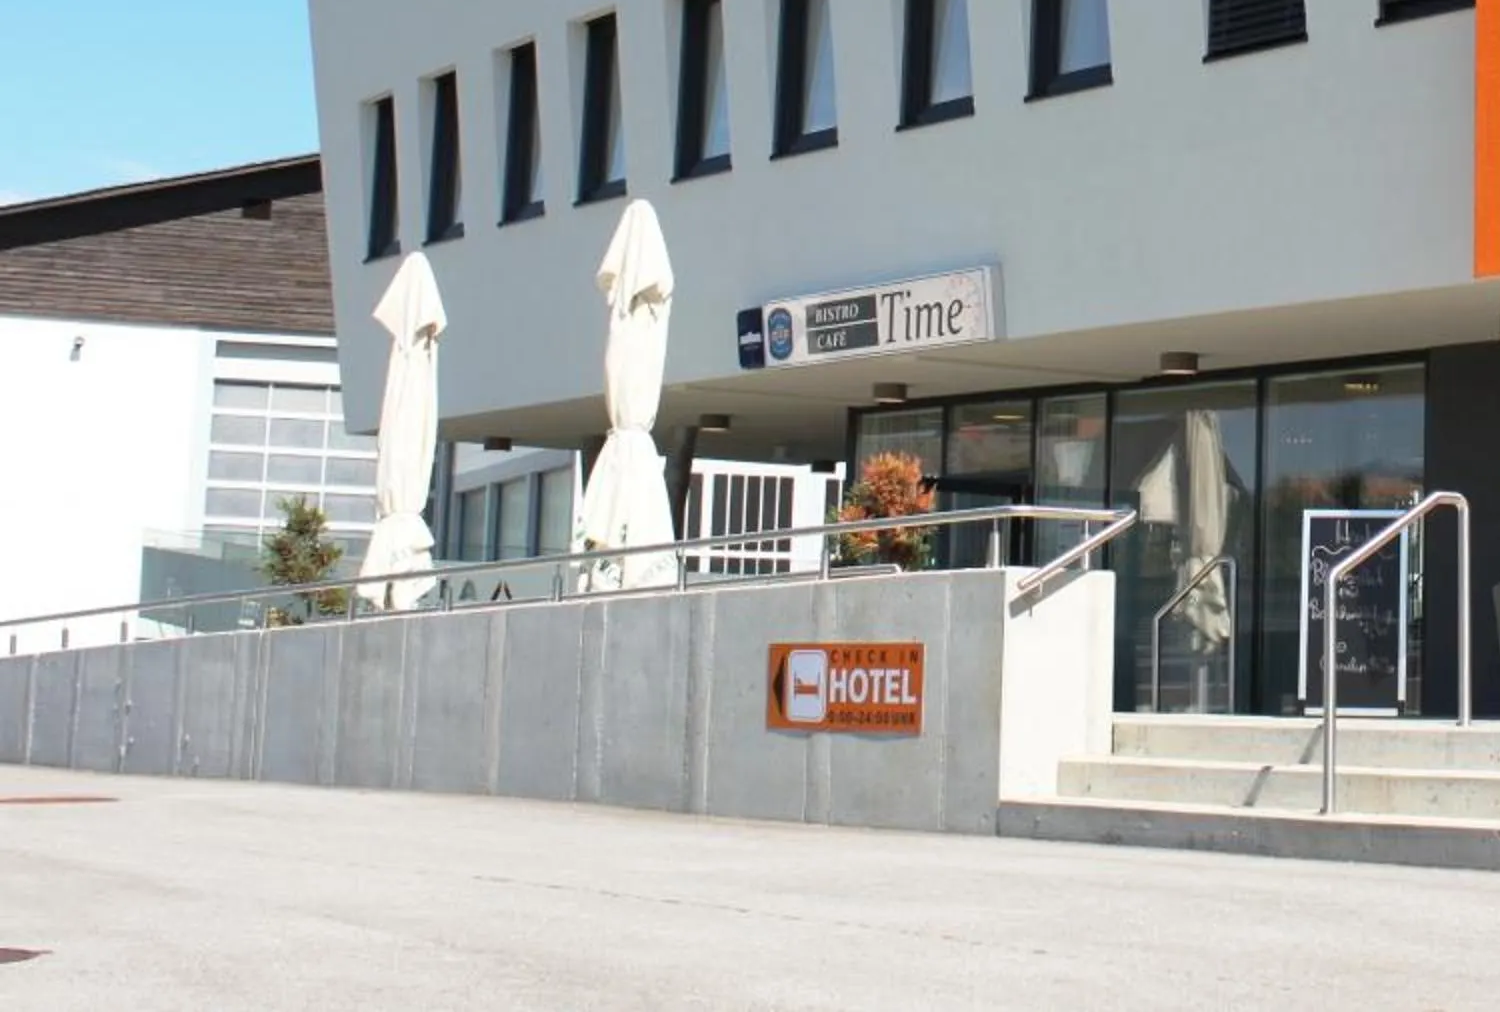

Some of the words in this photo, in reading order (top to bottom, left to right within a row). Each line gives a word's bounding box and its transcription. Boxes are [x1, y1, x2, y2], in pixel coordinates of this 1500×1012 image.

[815, 303, 859, 324] BISTRO
[881, 291, 964, 343] Time
[831, 649, 888, 664] CHECK
[829, 668, 917, 705] HOTEL
